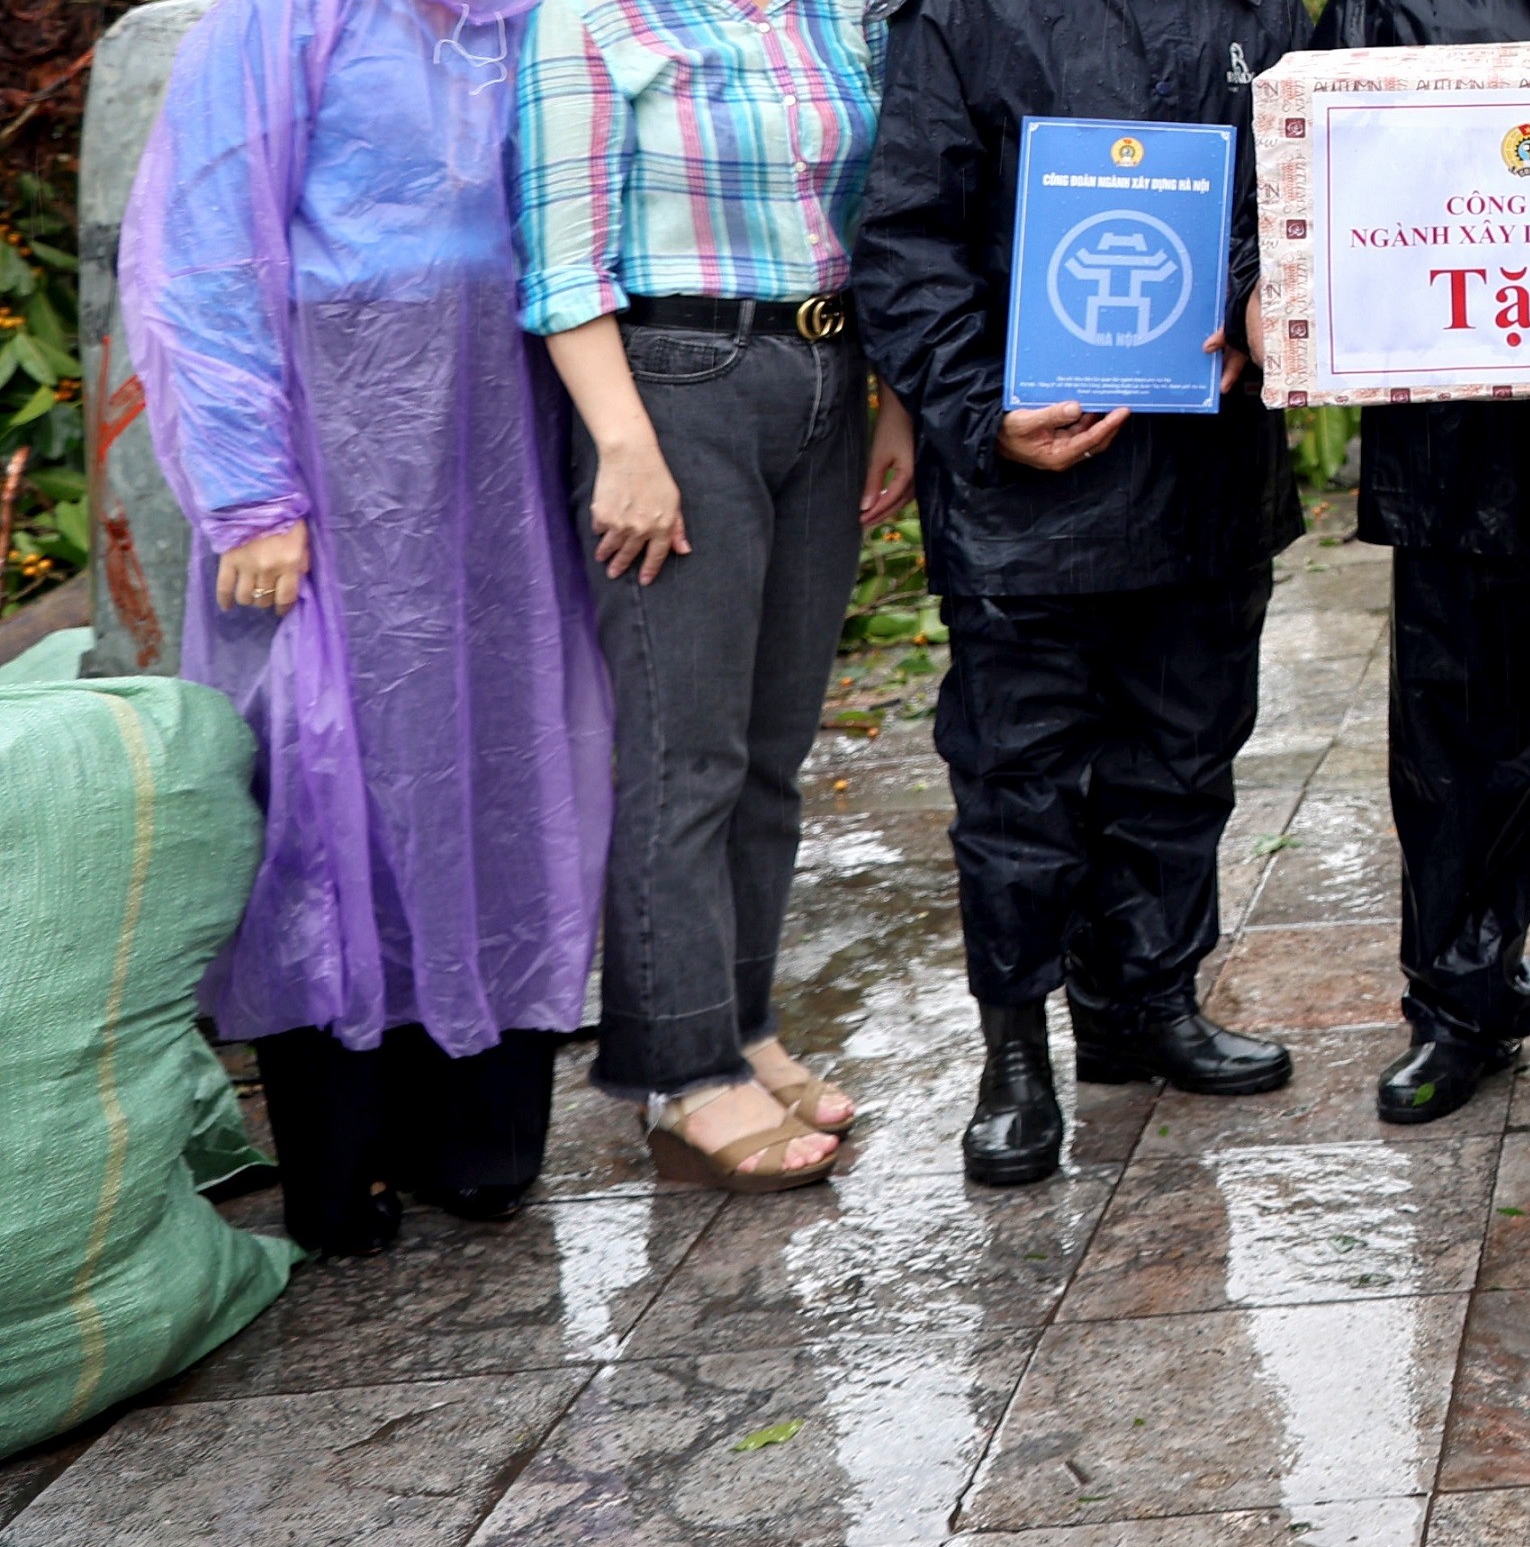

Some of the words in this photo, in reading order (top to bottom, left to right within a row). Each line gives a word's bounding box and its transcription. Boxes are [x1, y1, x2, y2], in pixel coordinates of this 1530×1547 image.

[1042, 172, 1070, 187] CÔNG
[1070, 173, 1097, 188] ĐOÀN
[1097, 174, 1130, 189] NGÀNH
[1131, 175, 1150, 190] XÂY
[1446, 190, 1526, 215] CÔNG
[1351, 219, 1450, 248] NGÀNH
[1460, 218, 1514, 246] XÂY
